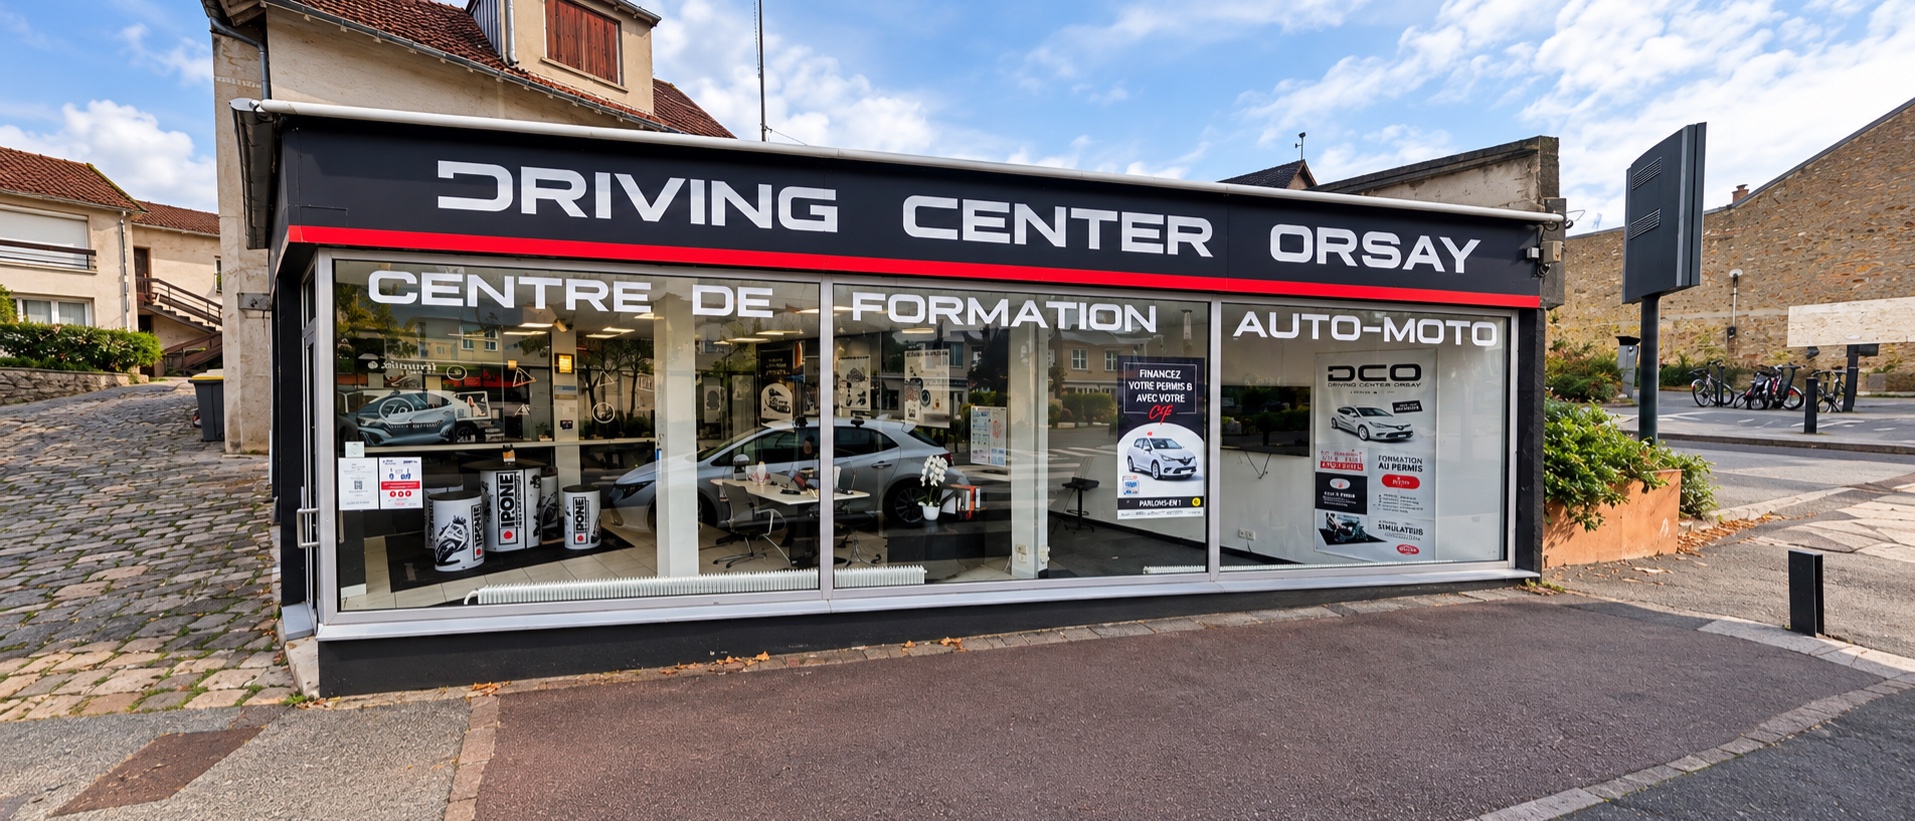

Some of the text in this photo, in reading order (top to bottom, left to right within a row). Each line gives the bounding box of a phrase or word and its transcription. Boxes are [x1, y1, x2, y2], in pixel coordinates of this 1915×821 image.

[437, 160, 1481, 274] DRIVING CENTER ORSAY
[368, 270, 1498, 347] CENTRE DE FORMATION AUTO-MOTO
[1139, 369, 1181, 379] FINANCEZ
[1328, 363, 1422, 382] DCO
[1128, 381, 1155, 390] VOTRE
[1156, 381, 1185, 391] PERMIS
[1136, 393, 1186, 403] AVEC VOTRE
[1378, 462, 1423, 473] AU PERMIS
[500, 474, 515, 527] IPONE
